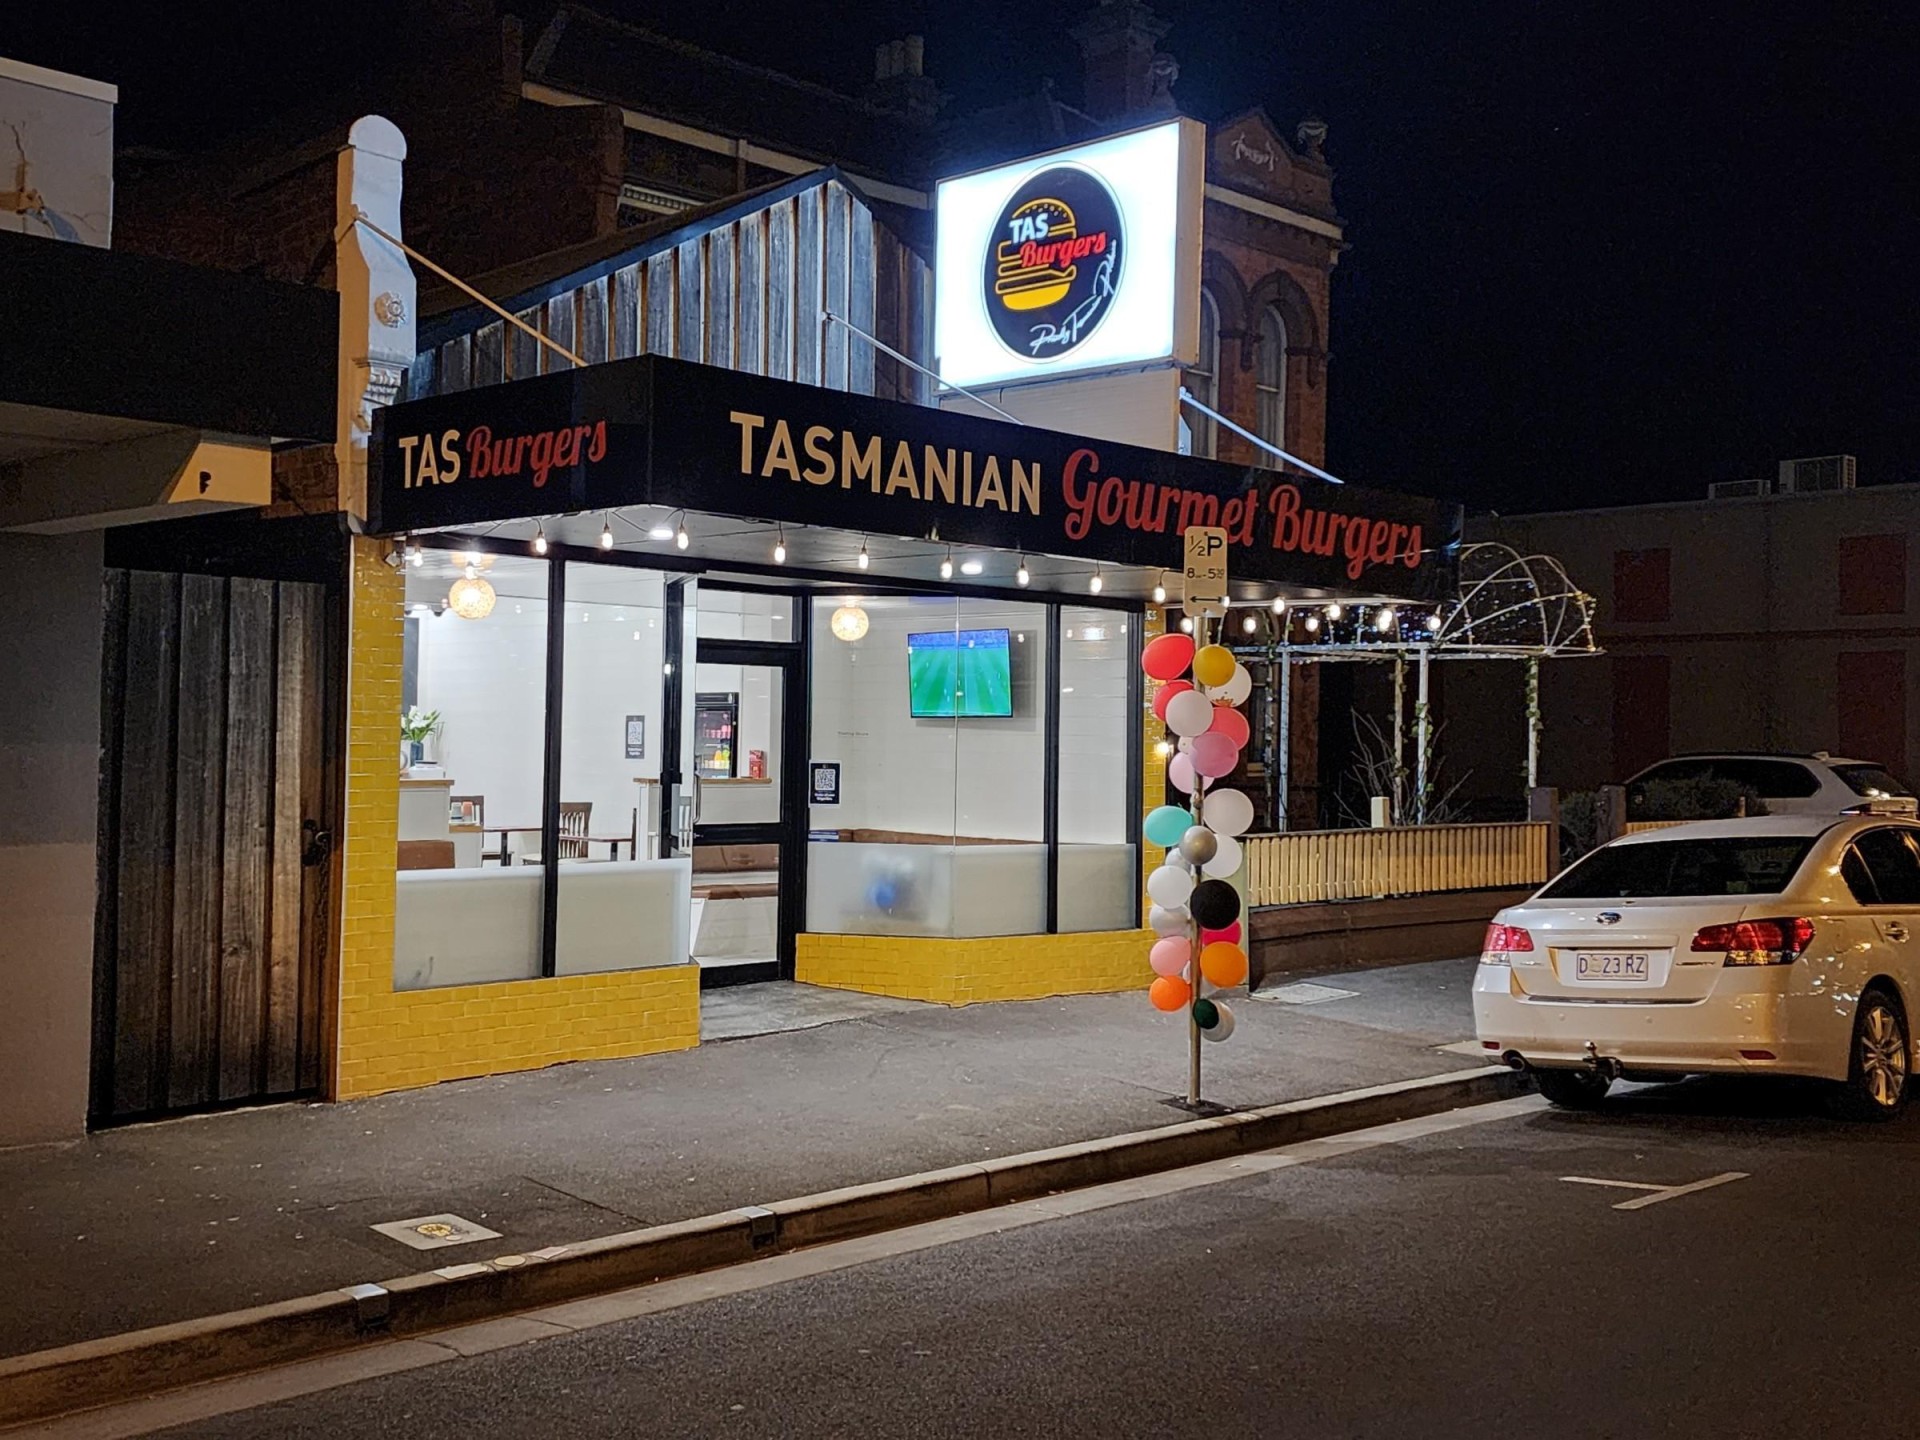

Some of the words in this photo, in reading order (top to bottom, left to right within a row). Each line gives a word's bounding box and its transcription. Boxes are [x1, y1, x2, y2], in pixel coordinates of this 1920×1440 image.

[1008, 212, 1049, 244] TAS
[1019, 231, 1106, 268] Burgers
[399, 429, 461, 488] TAS
[466, 420, 607, 488] Burgers
[730, 411, 1041, 515] TASMANIAN
[1062, 449, 1259, 547] Gourmet
[1269, 484, 1422, 580] Burgers
[1603, 957, 1620, 974] 23
[1626, 956, 1645, 974] RZ
